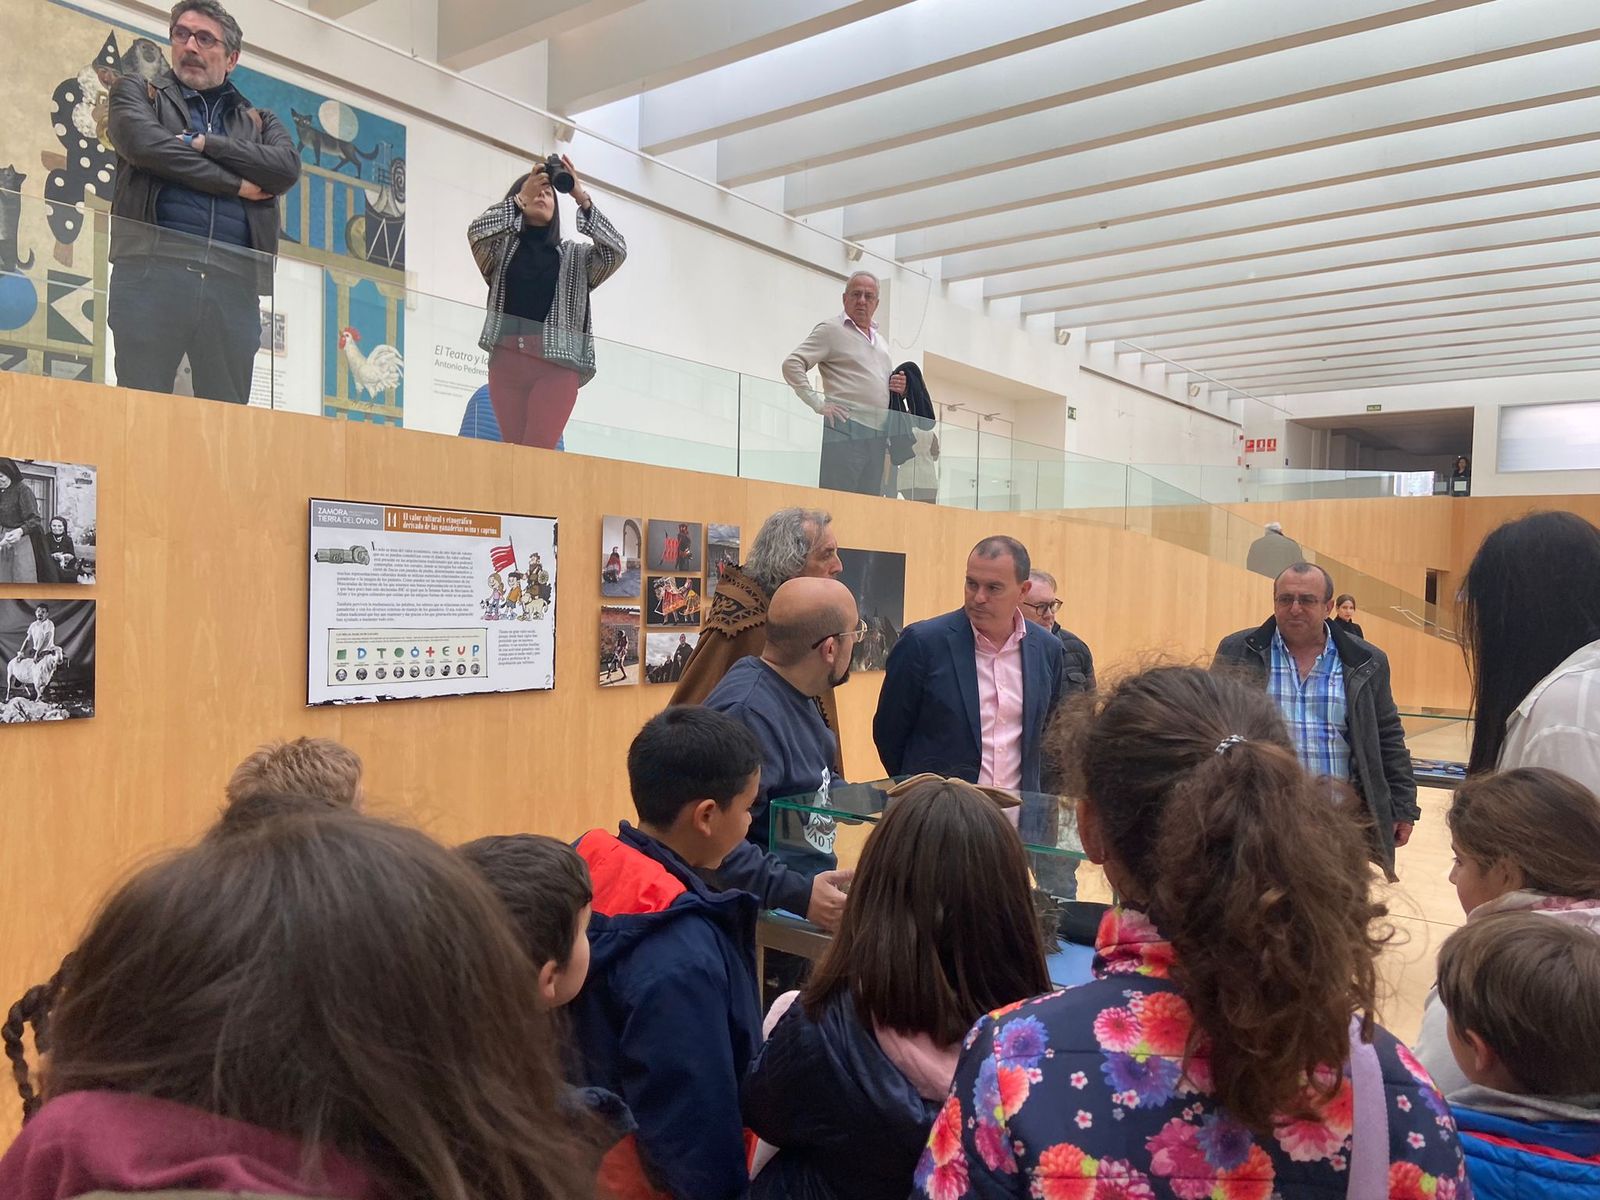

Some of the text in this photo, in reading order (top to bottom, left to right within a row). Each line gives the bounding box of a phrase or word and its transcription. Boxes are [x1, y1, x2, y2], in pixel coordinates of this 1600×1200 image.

[434, 344, 444, 356] El
[445, 346, 473, 362] Teatro
[474, 356, 480, 365] y
[434, 359, 463, 372] Antonio
[318, 507, 348, 516] ZAMORA
[318, 515, 379, 526] TIERRA DEL OVINO
[409, 513, 422, 522] valor
[422, 514, 442, 523] cultural
